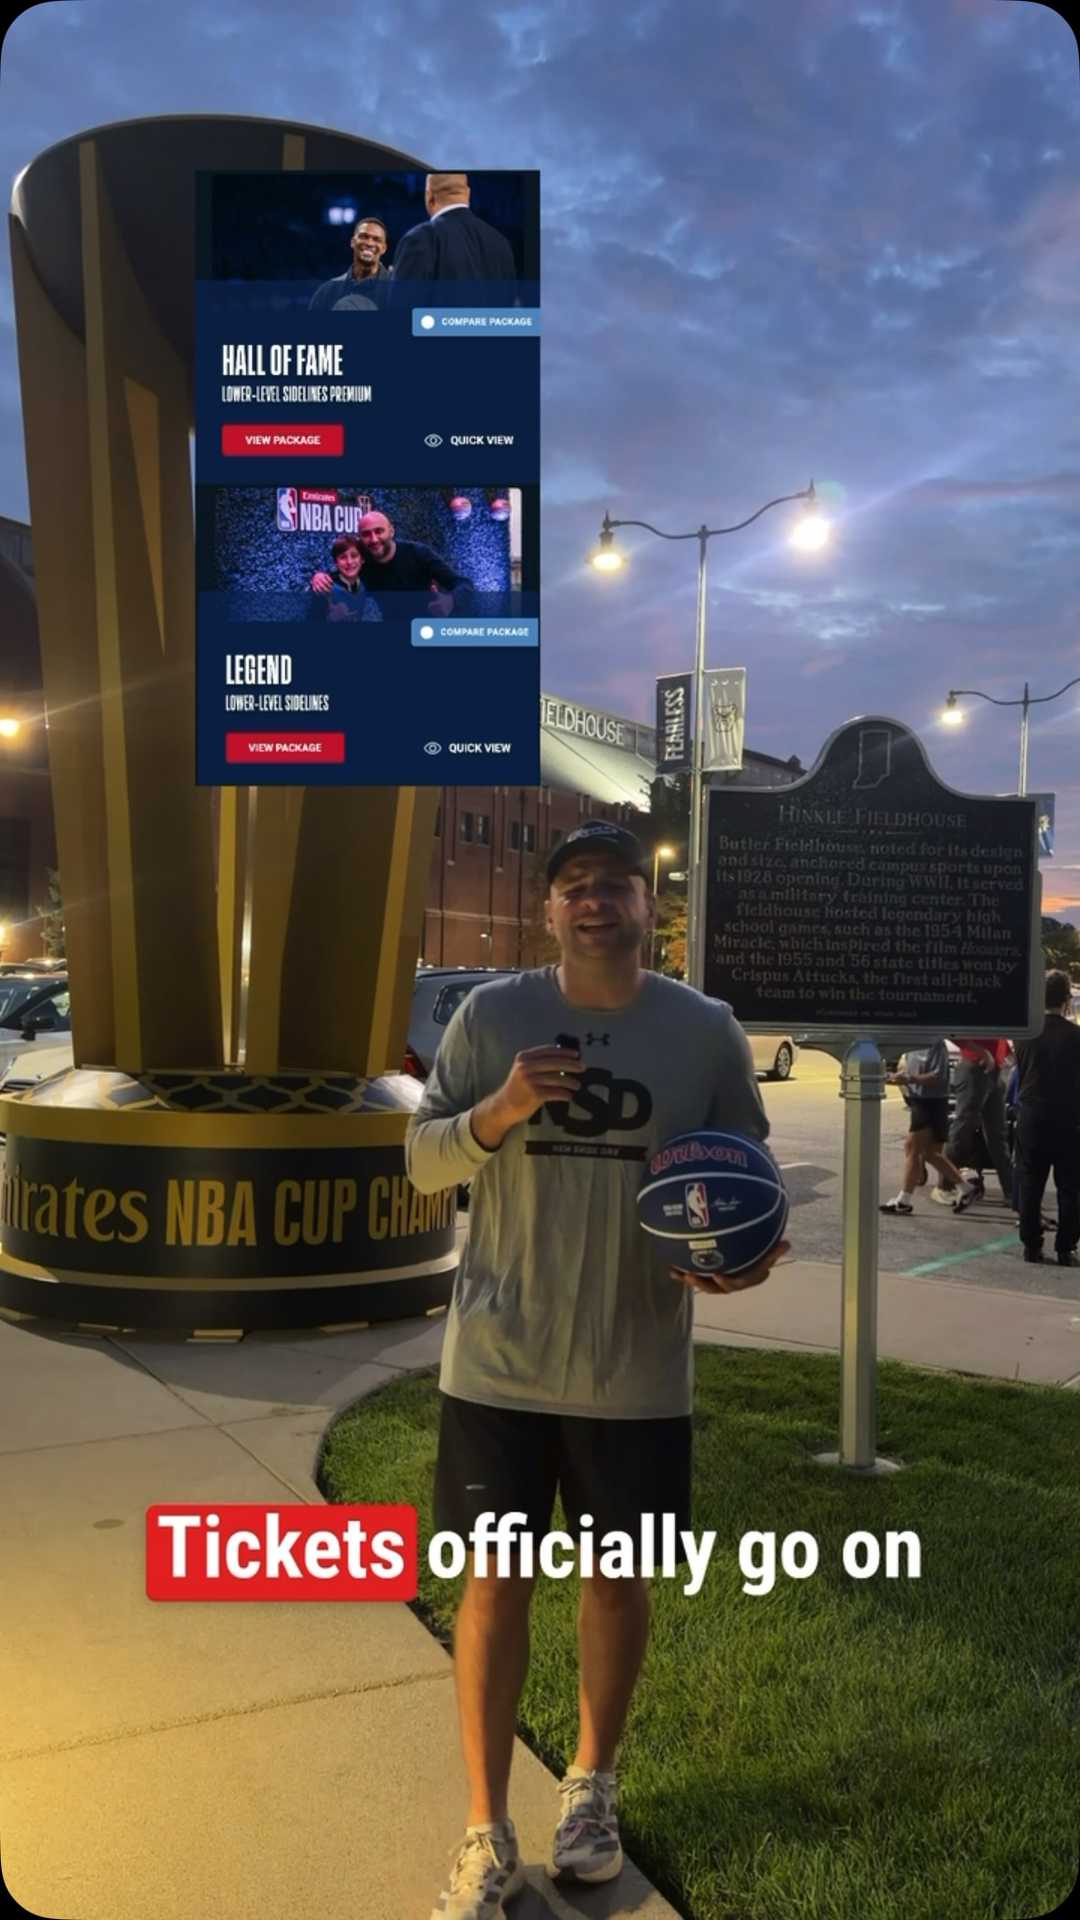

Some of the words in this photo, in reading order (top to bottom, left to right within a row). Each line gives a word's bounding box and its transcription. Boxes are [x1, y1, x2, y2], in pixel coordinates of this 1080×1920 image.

[541, 698, 625, 745] IELDHOUSE
[664, 687, 686, 761] FEARLESS
[778, 804, 848, 825] HINKLE
[855, 807, 968, 828] FIELDHOUSE
[719, 835, 771, 851] Butler
[869, 841, 917, 856] noted
[919, 842, 945, 857] for
[947, 843, 968, 857] its
[969, 843, 1024, 863] design
[718, 852, 748, 867] and
[789, 855, 866, 872] anchored
[867, 860, 929, 876] campus
[929, 862, 980, 879] sports
[983, 864, 1023, 879] upon
[716, 869, 735, 881] its
[737, 870, 772, 883] 1928
[847, 871, 906, 891] During
[957, 876, 969, 889] it
[971, 879, 1024, 891] served
[737, 888, 755, 900] as
[757, 889, 769, 900] a
[770, 887, 838, 904] military
[842, 889, 907, 908] training
[968, 892, 1001, 907] The
[736, 903, 820, 918] fieldhouse
[823, 906, 878, 919] hosted
[881, 906, 962, 925] legendary
[966, 909, 1002, 925] high
[723, 919, 775, 934] school
[833, 922, 870, 937] such
[874, 925, 892, 937] as
[895, 923, 922, 938] the
[924, 923, 963, 938] 1954
[967, 924, 1012, 940] Milan
[778, 935, 824, 951] which
[825, 937, 891, 956] inspired
[894, 939, 921, 954] the
[924, 940, 957, 955] film
[715, 951, 745, 966] and
[750, 952, 774, 966] the
[777, 952, 813, 967] 1955
[815, 953, 845, 968] and
[872, 956, 913, 970] state
[917, 957, 961, 971] titles
[961, 958, 993, 971] won
[994, 958, 1019, 975] by
[730, 967, 791, 985] Crispus
[863, 971, 889, 986] the
[892, 972, 928, 987] first
[931, 972, 1003, 988] all-Black
[756, 986, 796, 1001] team
[797, 987, 816, 1001] to
[817, 988, 845, 1001] win
[848, 988, 875, 1002] the
[165, 1179, 257, 1248] NBA
[273, 1177, 357, 1247] CUP
